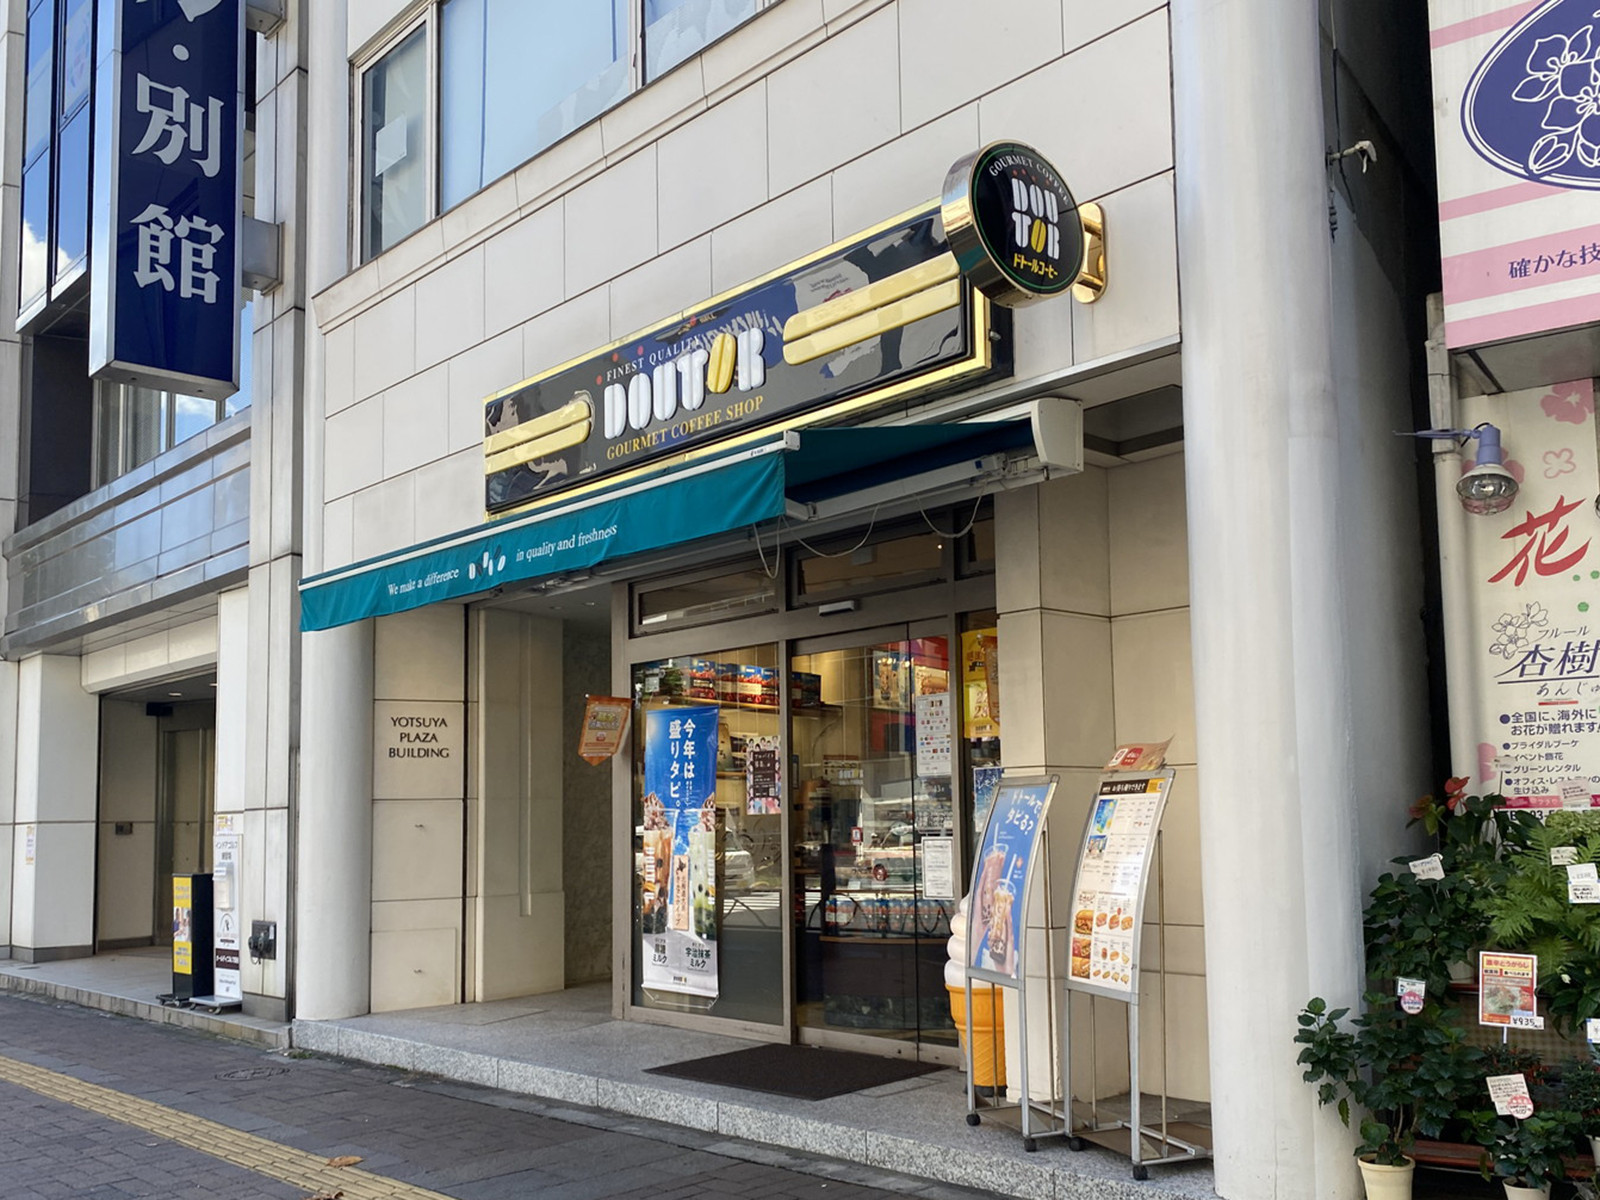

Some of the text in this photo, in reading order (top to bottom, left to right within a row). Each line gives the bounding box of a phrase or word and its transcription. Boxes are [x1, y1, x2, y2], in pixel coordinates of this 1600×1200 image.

[989, 155, 1069, 206] GOURMET COFFEE
[1013, 253, 1058, 279] ドトールコーヒー
[1508, 242, 1600, 279] 確かな技
[606, 334, 701, 382] FINEST QUALITY
[603, 327, 765, 440] DOUTOR
[606, 395, 764, 460] GOURMET COFFEE SHOP
[1487, 495, 1592, 587] 花
[388, 524, 618, 596] We make a difference in quality and freshness
[1530, 626, 1590, 643] フルール
[1494, 640, 1600, 678] 杏樹
[391, 716, 448, 728] YOTSUYA
[1511, 709, 1597, 724] 全国に、海外に
[400, 732, 438, 743] PLAZA
[683, 718, 696, 780] 今年は
[388, 747, 449, 758] BUILDING
[1513, 764, 1581, 774] グリーンレンタル
[1513, 786, 1549, 795] 生け込み
[653, 953, 667, 964] ミルク
[690, 958, 706, 968] ミルク
